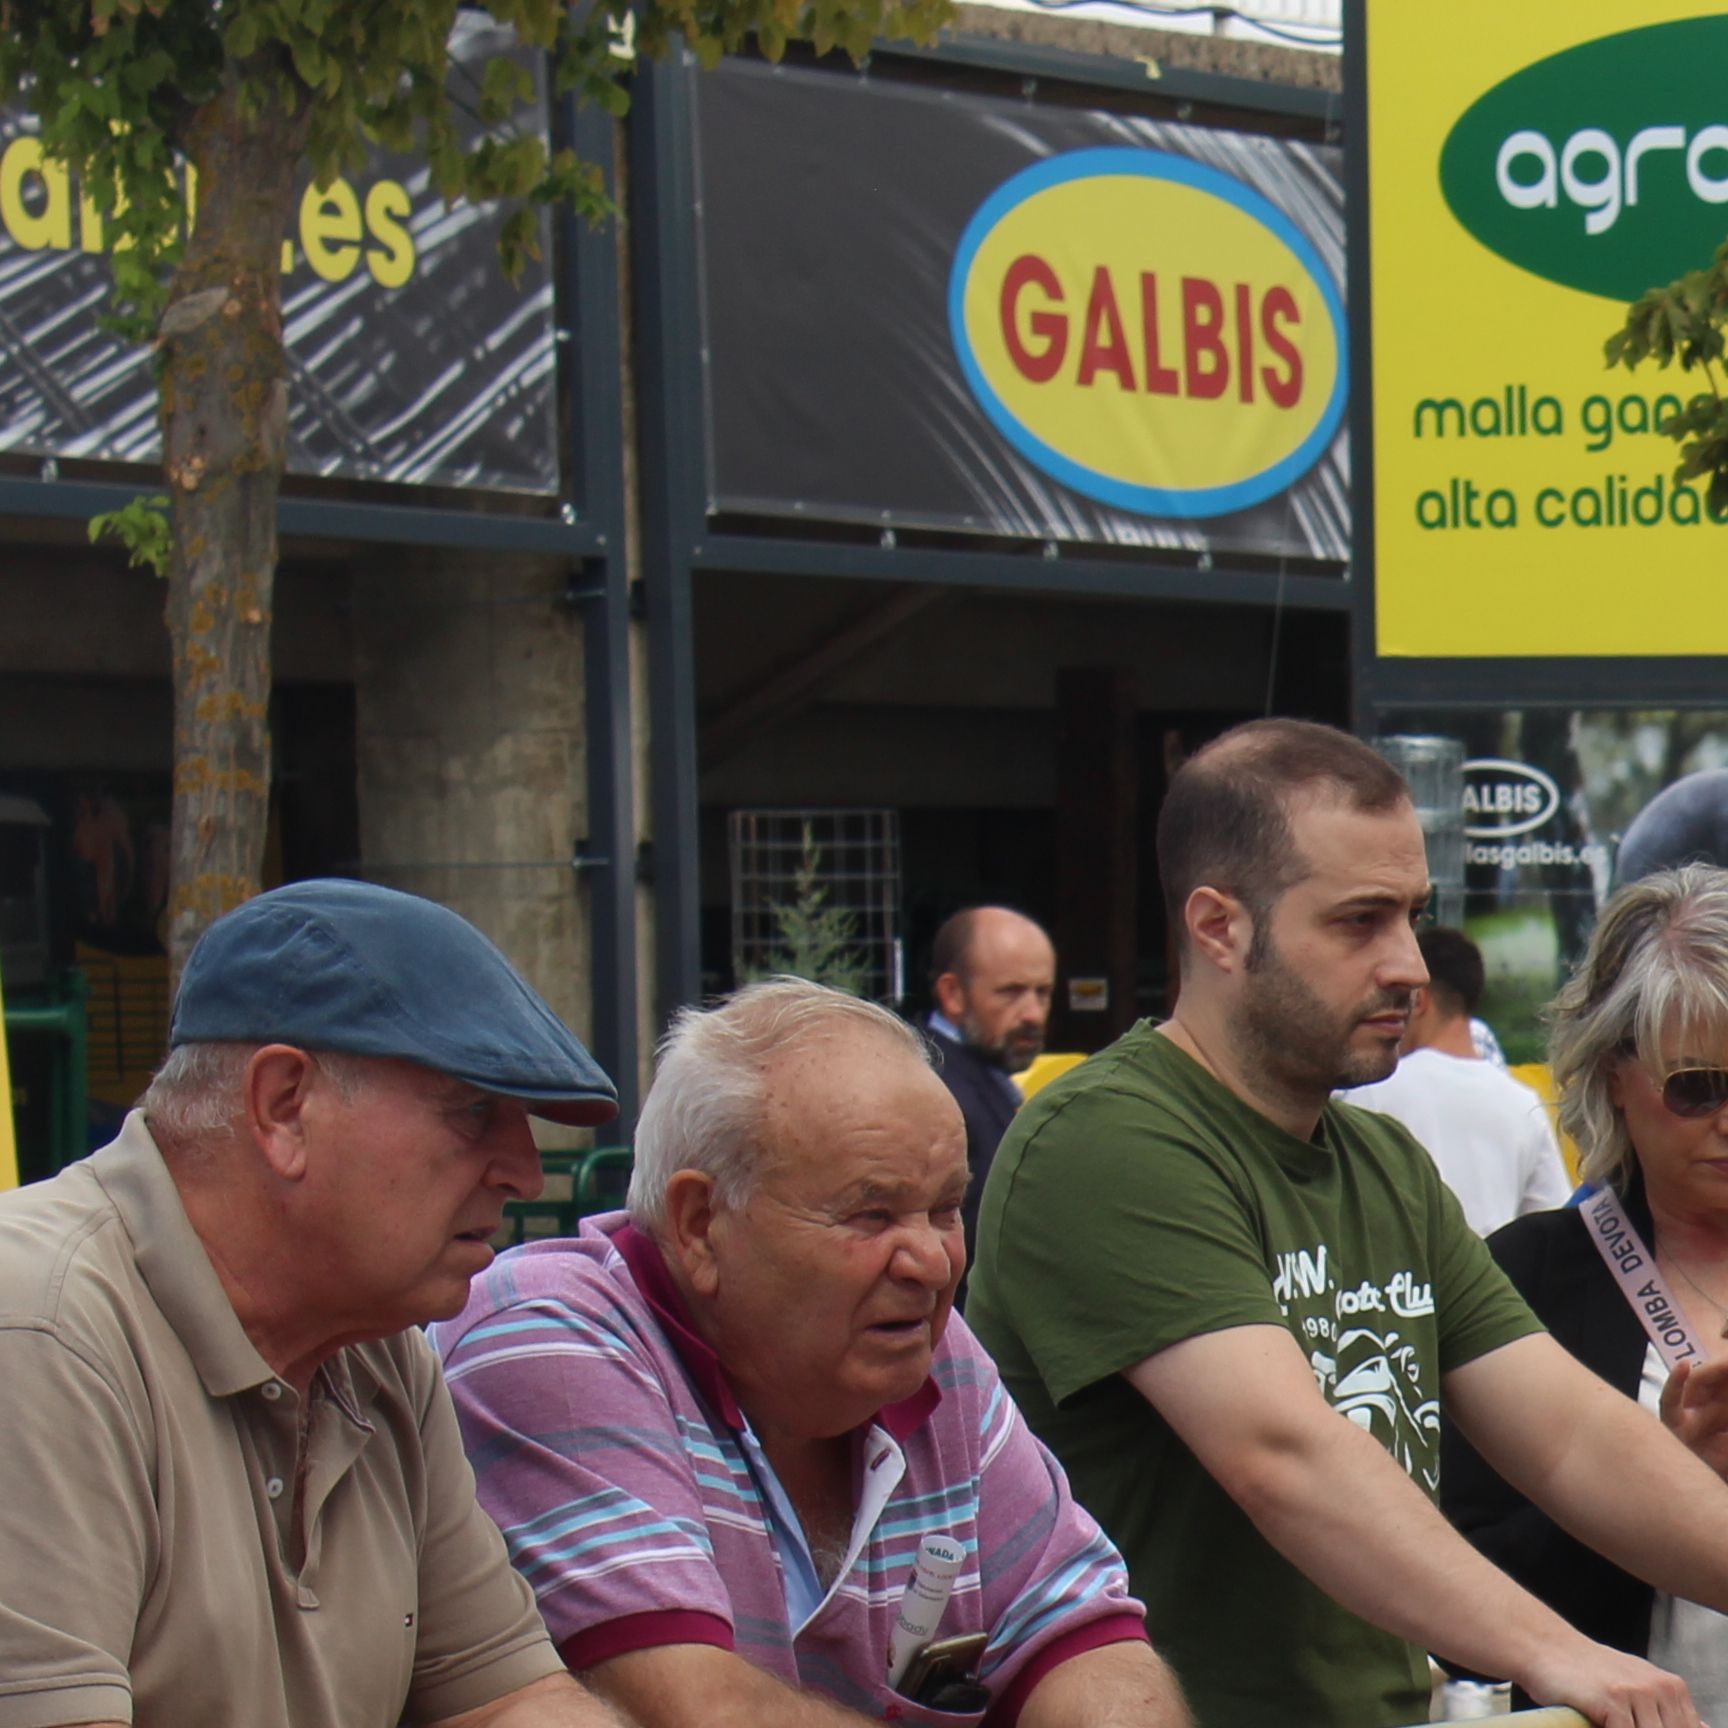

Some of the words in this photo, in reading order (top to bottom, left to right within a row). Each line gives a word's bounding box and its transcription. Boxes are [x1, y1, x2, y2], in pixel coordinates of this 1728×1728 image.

[998, 253, 1305, 410] GALBIS
[1413, 384, 1564, 438] malla
[1415, 478, 1518, 530] alta
[1461, 782, 1544, 815] ALBIS
[1593, 1195, 1643, 1275] DEVOTA
[1643, 1277, 1696, 1363] LOMBA
[925, 1546, 955, 1562] NADA
